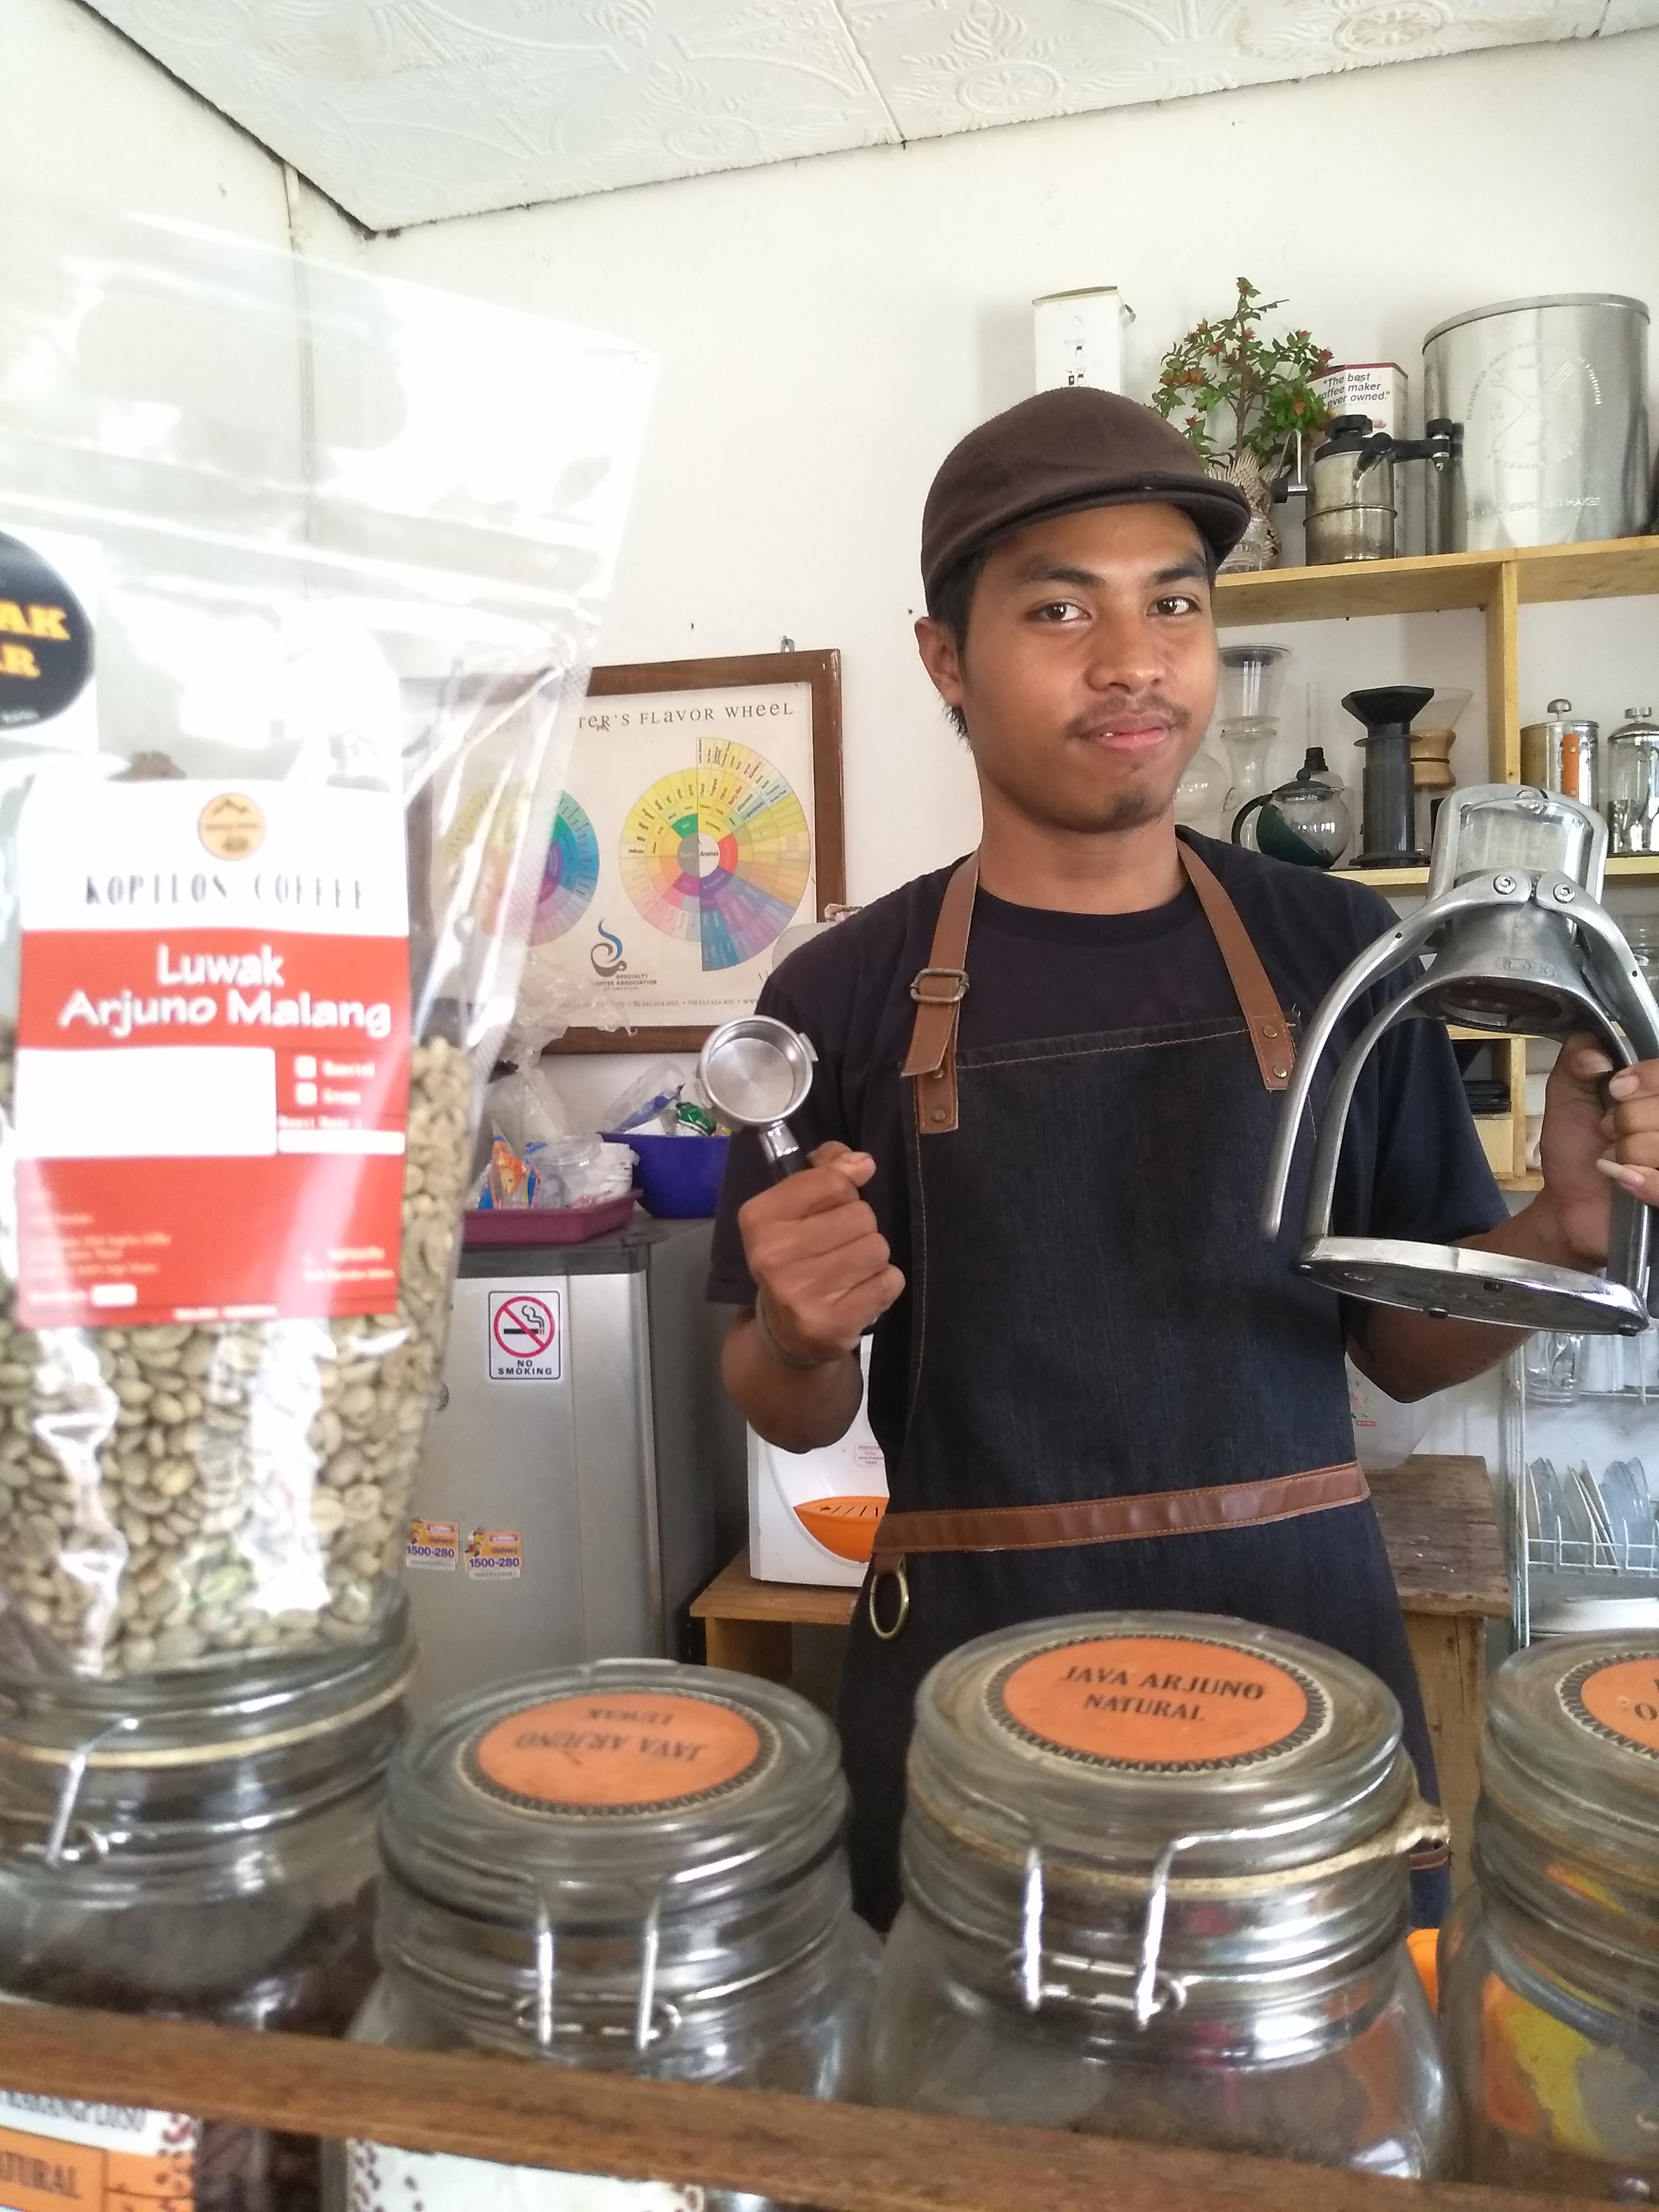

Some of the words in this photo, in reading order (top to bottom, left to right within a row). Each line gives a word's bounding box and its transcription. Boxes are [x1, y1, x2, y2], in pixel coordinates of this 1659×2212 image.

[1347, 373, 1370, 382] best
[1348, 382, 1381, 392] maker
[1327, 395, 1347, 408] ever
[157, 944, 285, 987] Luwak
[58, 989, 217, 1037] Arjuno
[226, 989, 392, 1038] Malang
[407, 1545, 455, 1558] 1500-280
[469, 1557, 520, 1568] 1500-280
[1058, 1665, 1129, 1688] JAVA
[1138, 1672, 1265, 1701] ARJUNO
[1082, 1693, 1206, 1722] NATURAL
